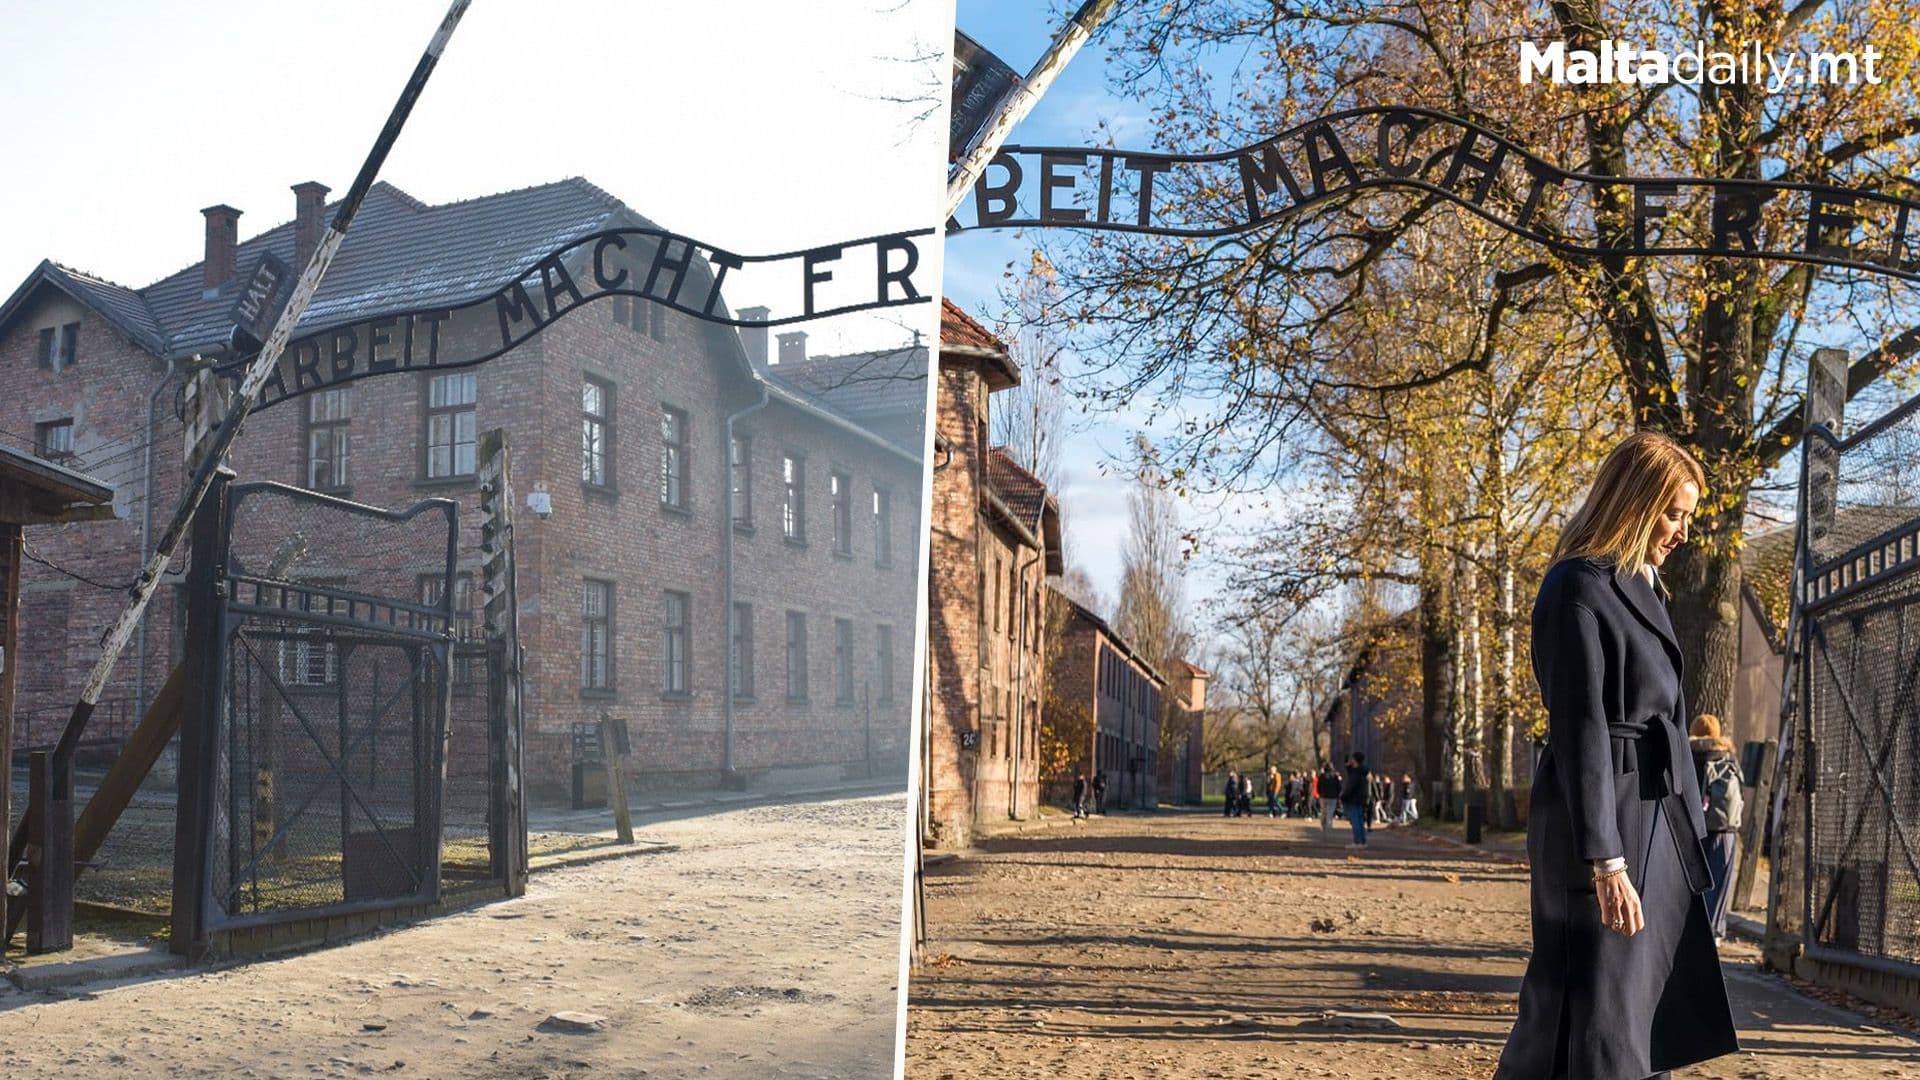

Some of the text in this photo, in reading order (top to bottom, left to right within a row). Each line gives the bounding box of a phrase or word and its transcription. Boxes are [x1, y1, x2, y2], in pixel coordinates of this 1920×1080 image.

[946, 152, 1170, 229] BEIT
[1238, 111, 1564, 227] MACHT
[238, 264, 276, 321] HALT
[497, 232, 743, 347] MACHT
[804, 236, 920, 316] FR
